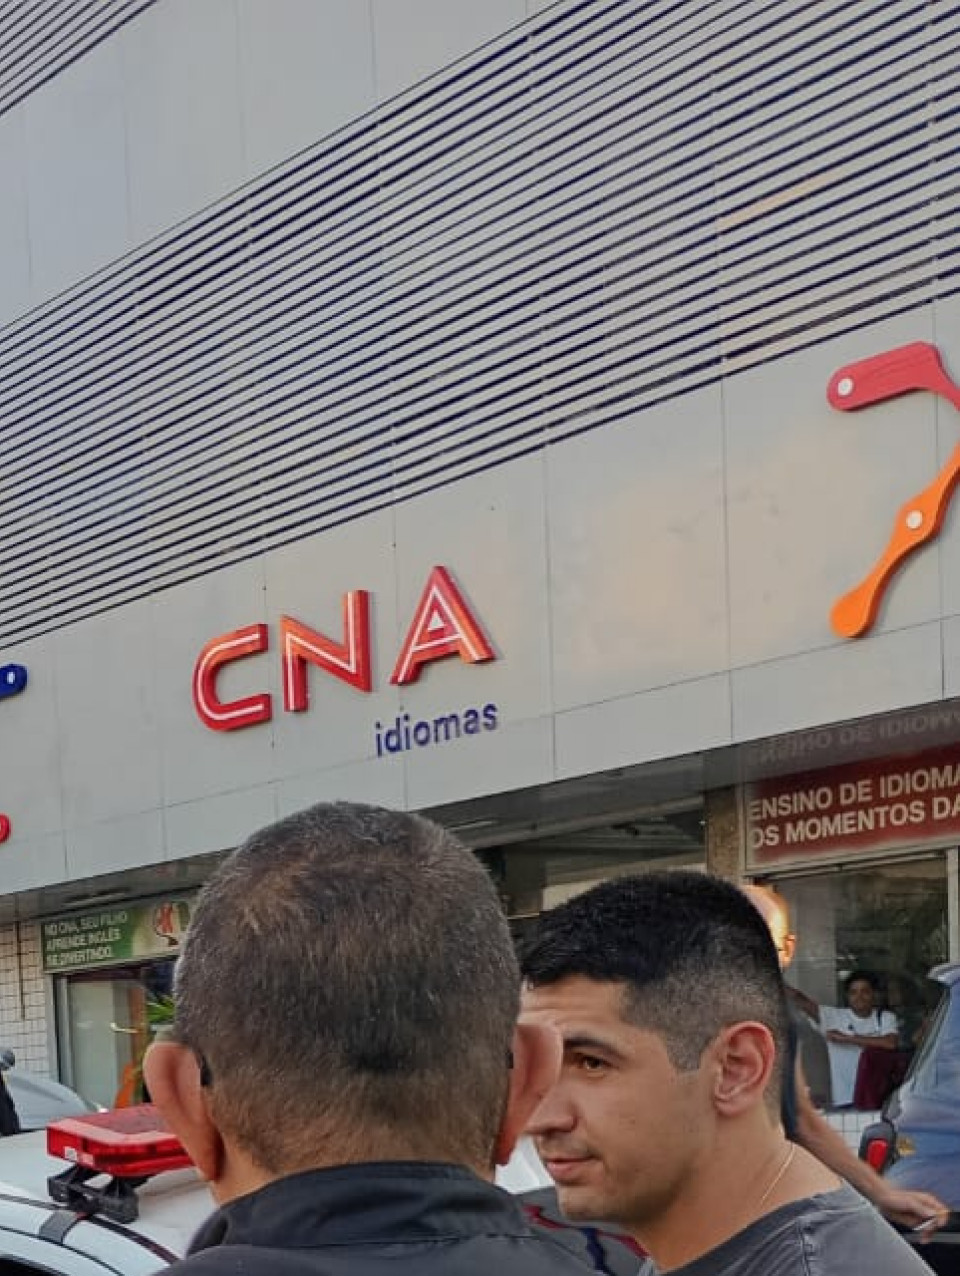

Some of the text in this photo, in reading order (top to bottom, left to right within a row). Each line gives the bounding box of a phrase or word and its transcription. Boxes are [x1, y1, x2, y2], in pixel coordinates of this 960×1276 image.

[192, 565, 497, 732] CNA
[374, 702, 499, 758] idiomas
[747, 786, 833, 822] ENSINO
[840, 779, 873, 804] DE
[785, 802, 925, 843] MOMENTOS
